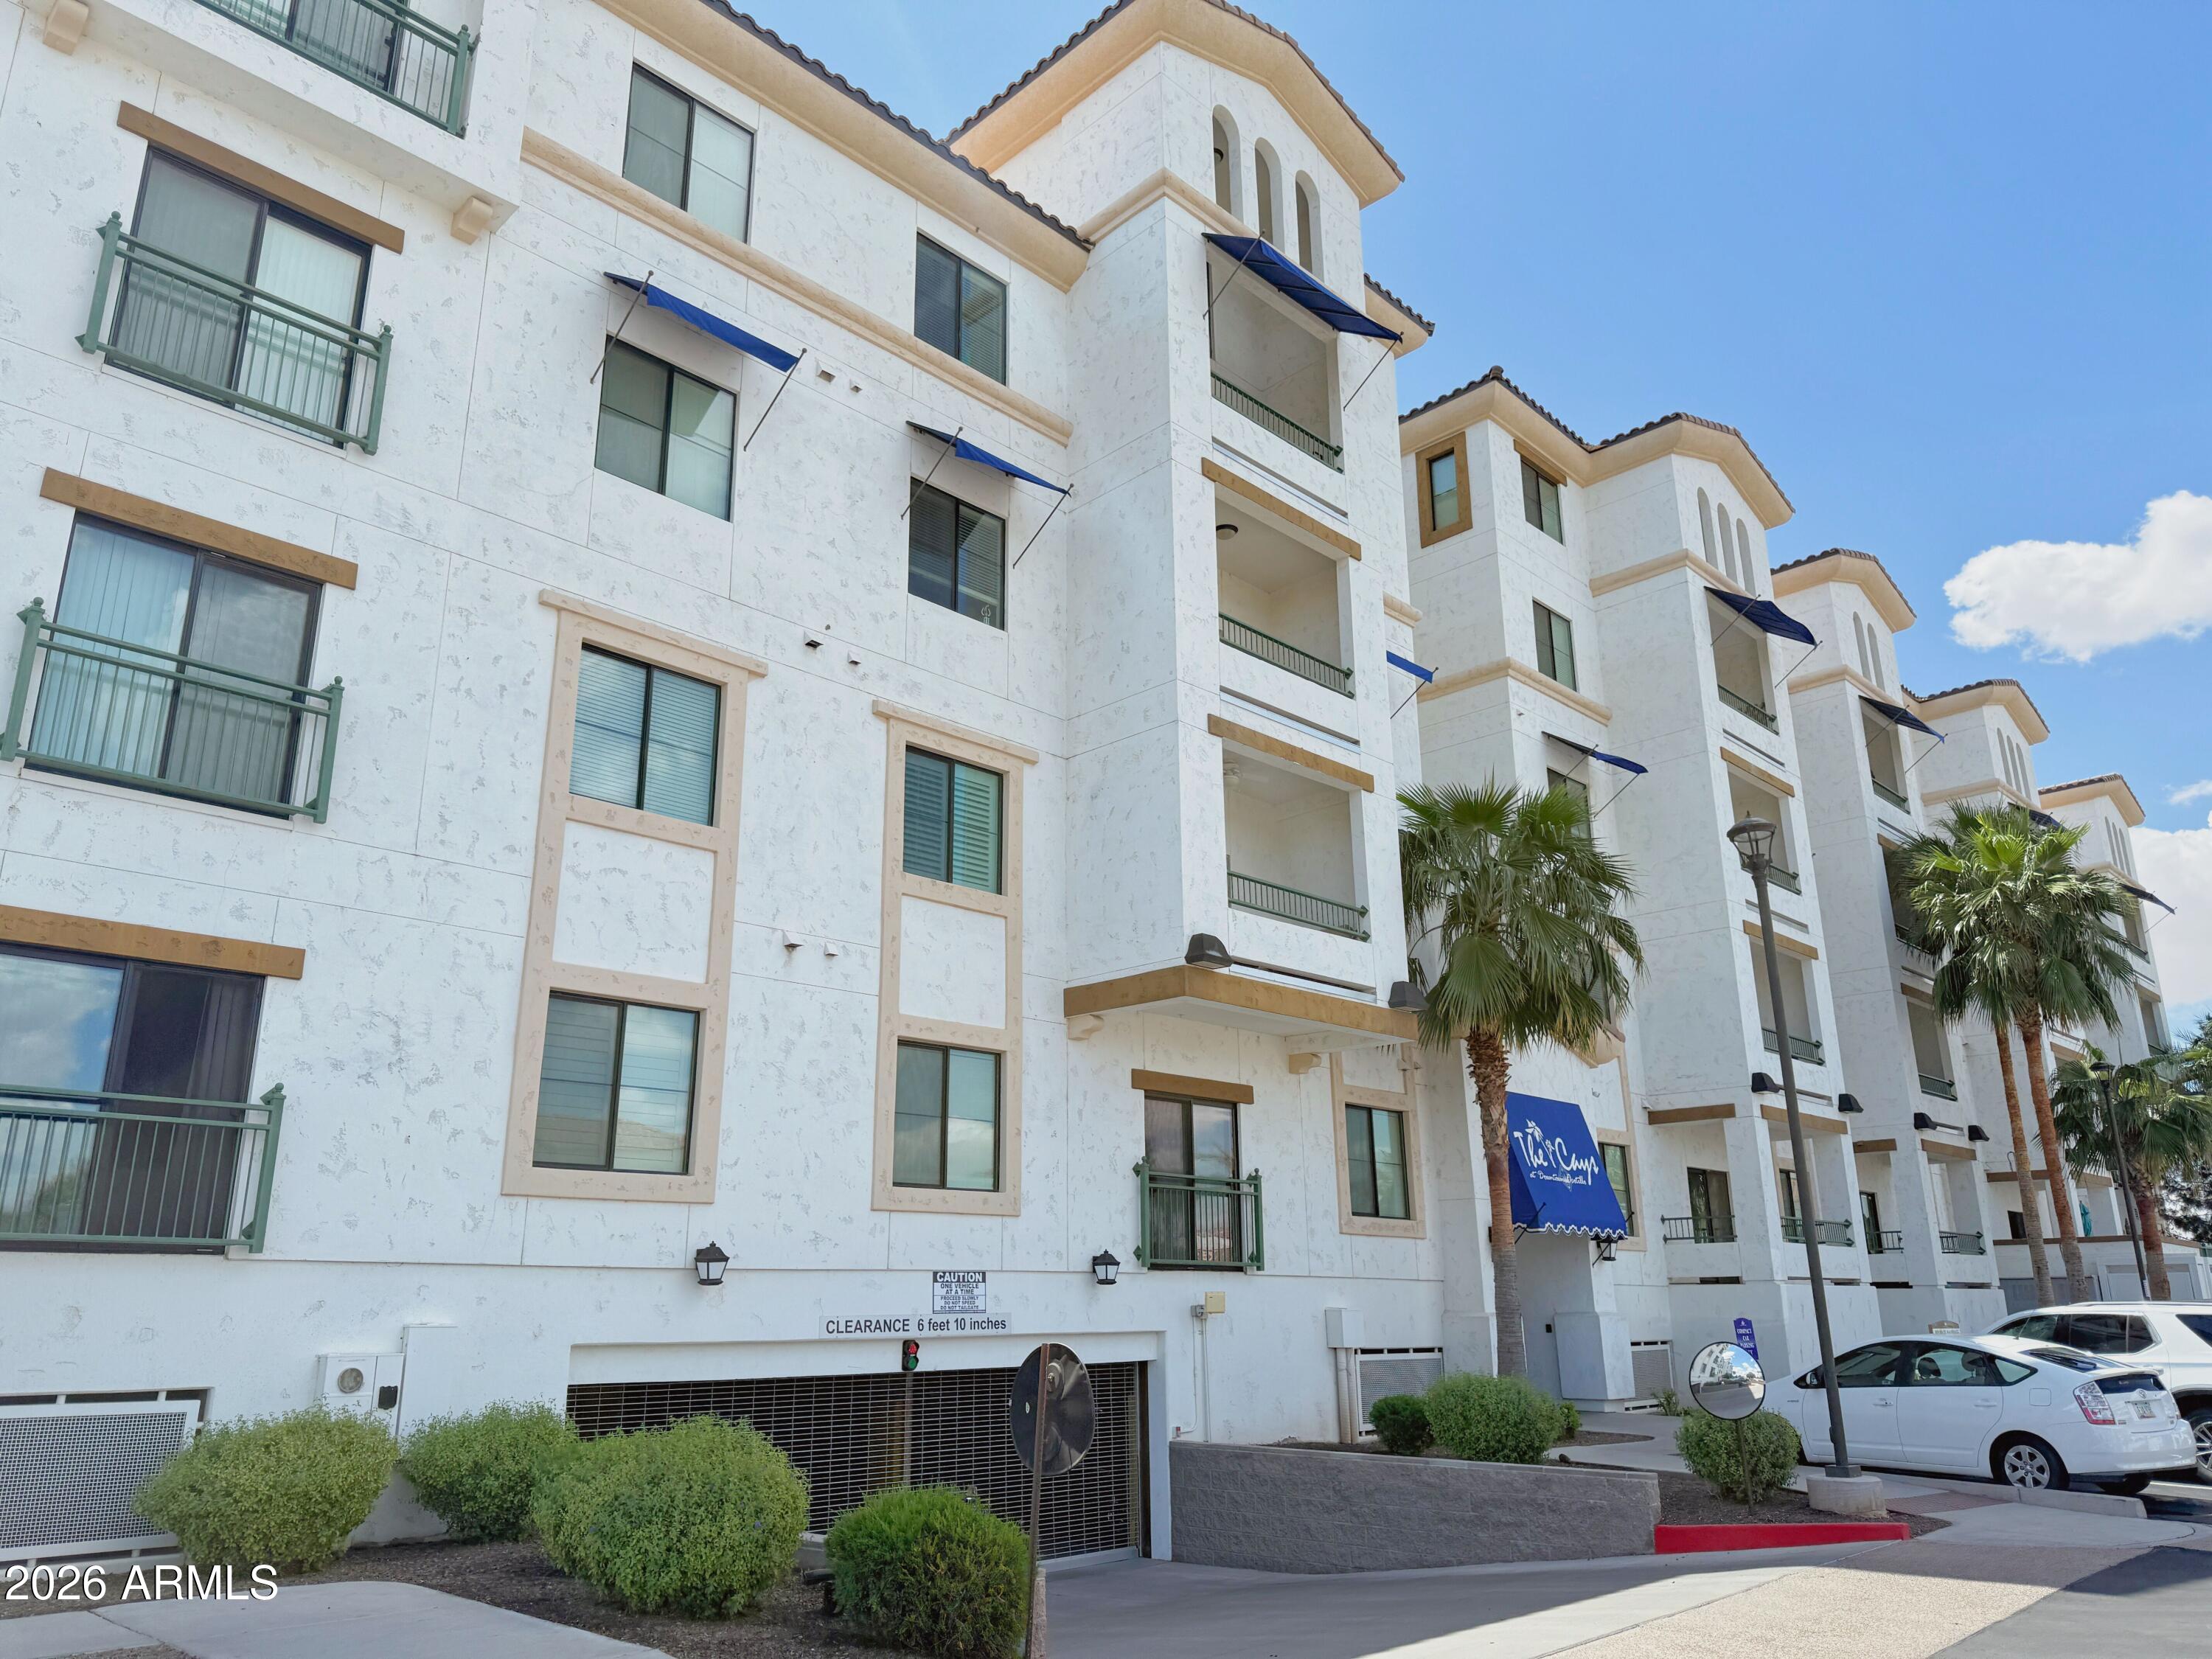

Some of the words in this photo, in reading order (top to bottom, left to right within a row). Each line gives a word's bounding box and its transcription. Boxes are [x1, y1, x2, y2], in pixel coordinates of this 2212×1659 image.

[1513, 1131, 1548, 1168] The
[1554, 1137, 1599, 1186] Cays
[936, 1272, 983, 1282] CAUTION
[826, 1318, 910, 1334] CLEARANCE
[917, 1318, 924, 1331] 6
[928, 1318, 950, 1331] feet
[954, 1318, 966, 1331] 10
[970, 1317, 1006, 1330] inches
